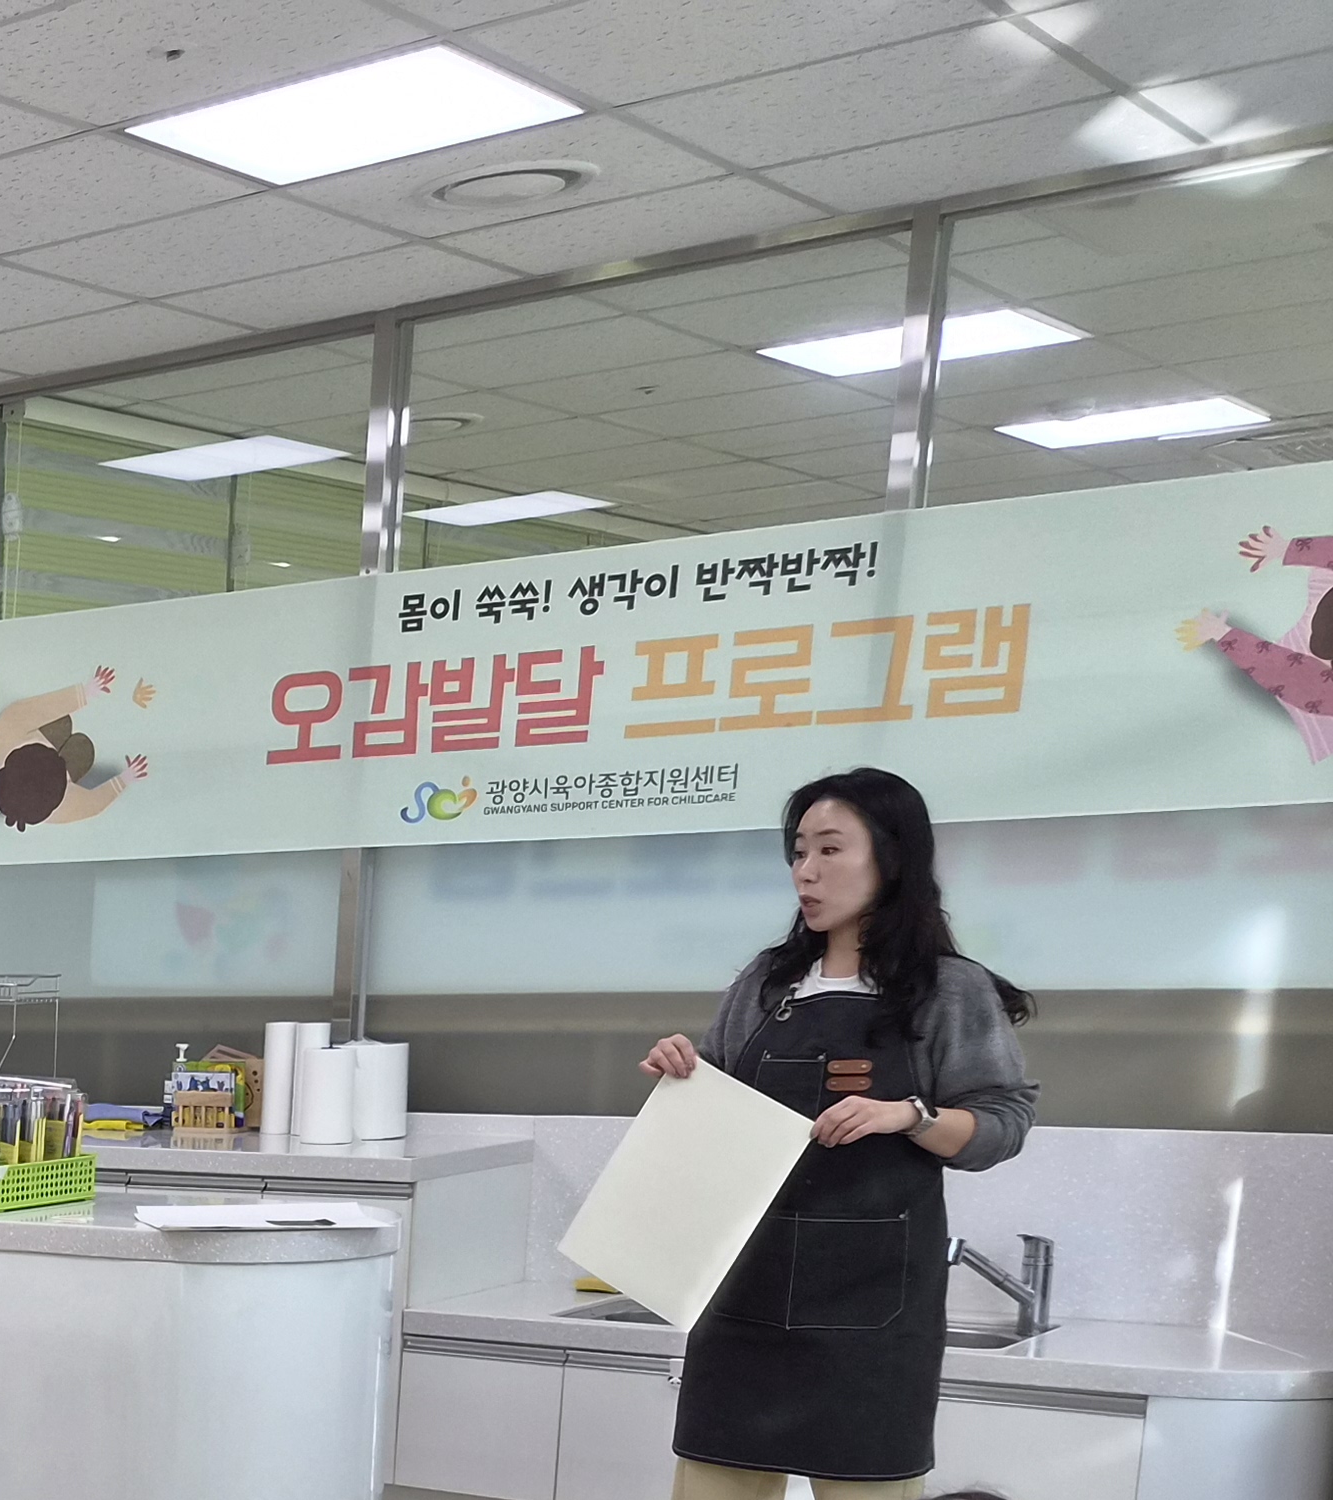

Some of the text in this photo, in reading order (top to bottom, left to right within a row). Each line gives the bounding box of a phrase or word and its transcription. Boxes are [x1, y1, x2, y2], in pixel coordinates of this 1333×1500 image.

[397, 542, 878, 633] 몸이 쑥쑥! 생각이 반짝반짝!
[265, 603, 1031, 765] 오감발달 프로그램
[483, 792, 736, 816] GWANGYANG SUPPORT CENTER FOR CHILDCARE
[485, 763, 739, 805] 광양시육아종합지원센터
